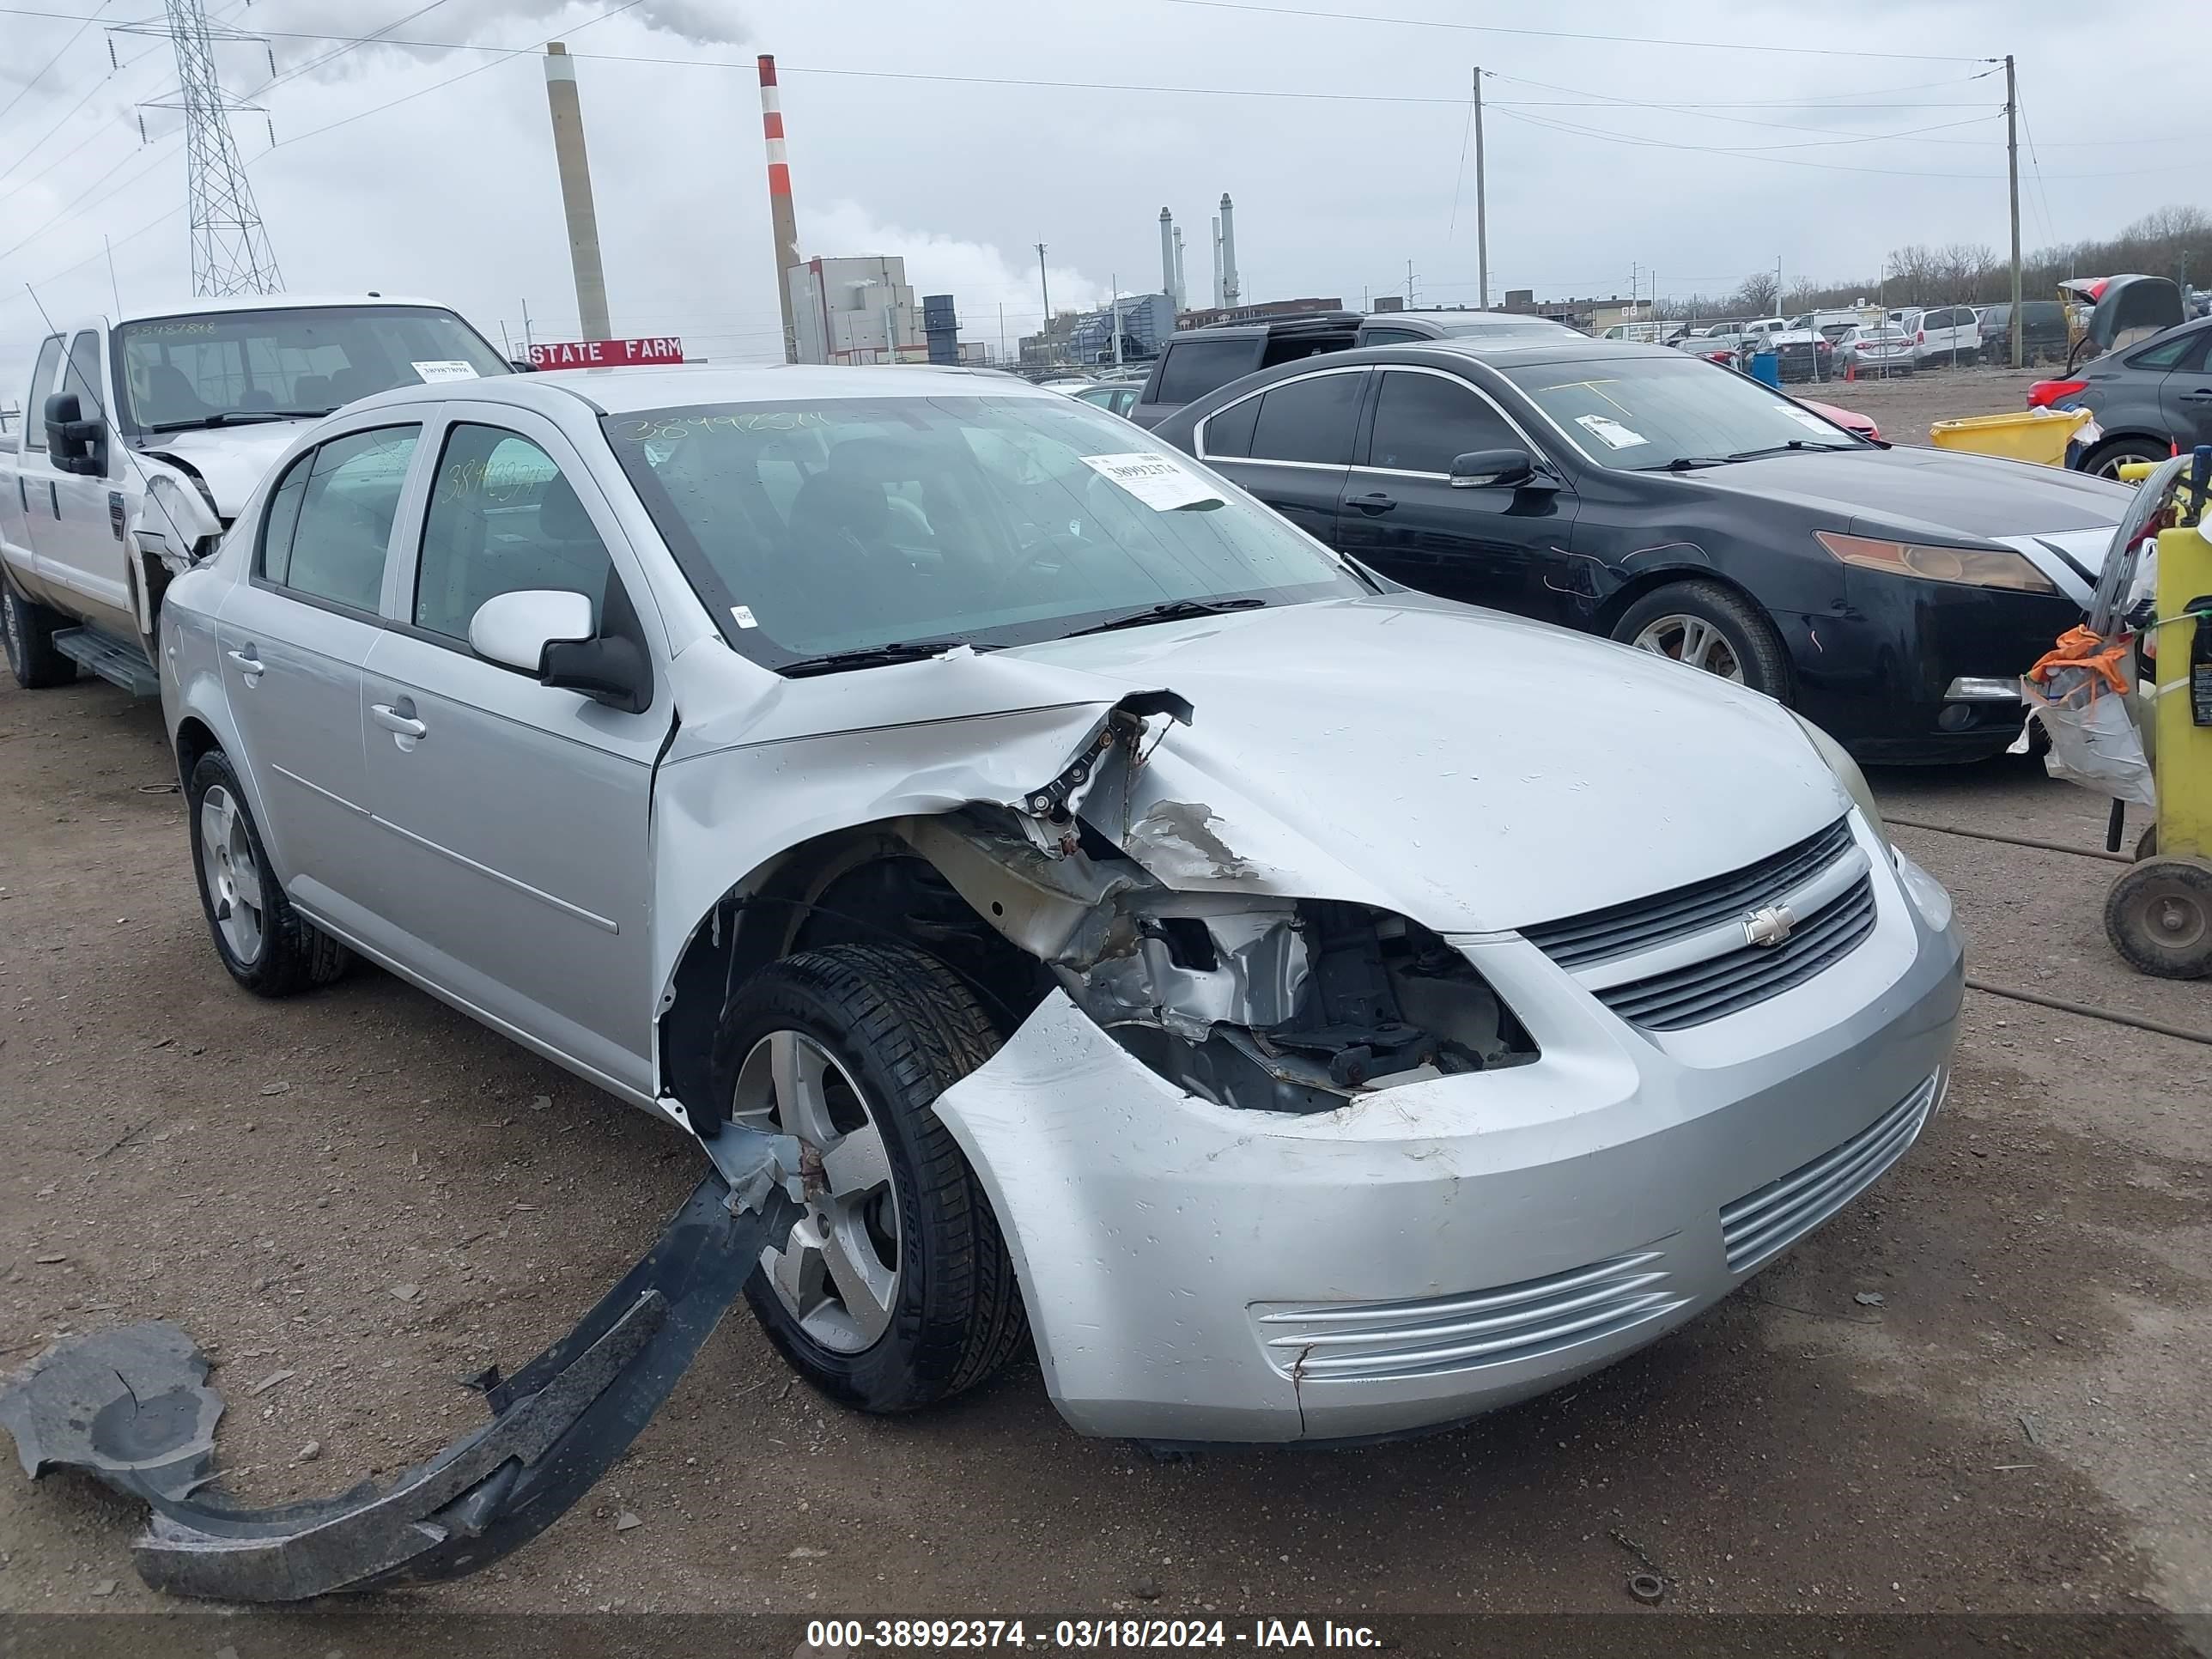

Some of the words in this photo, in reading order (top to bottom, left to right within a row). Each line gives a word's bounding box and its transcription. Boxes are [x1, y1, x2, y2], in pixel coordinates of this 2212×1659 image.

[530, 343, 604, 364] STATE
[625, 338, 682, 359] FARM
[1107, 464, 1181, 478] 38992374
